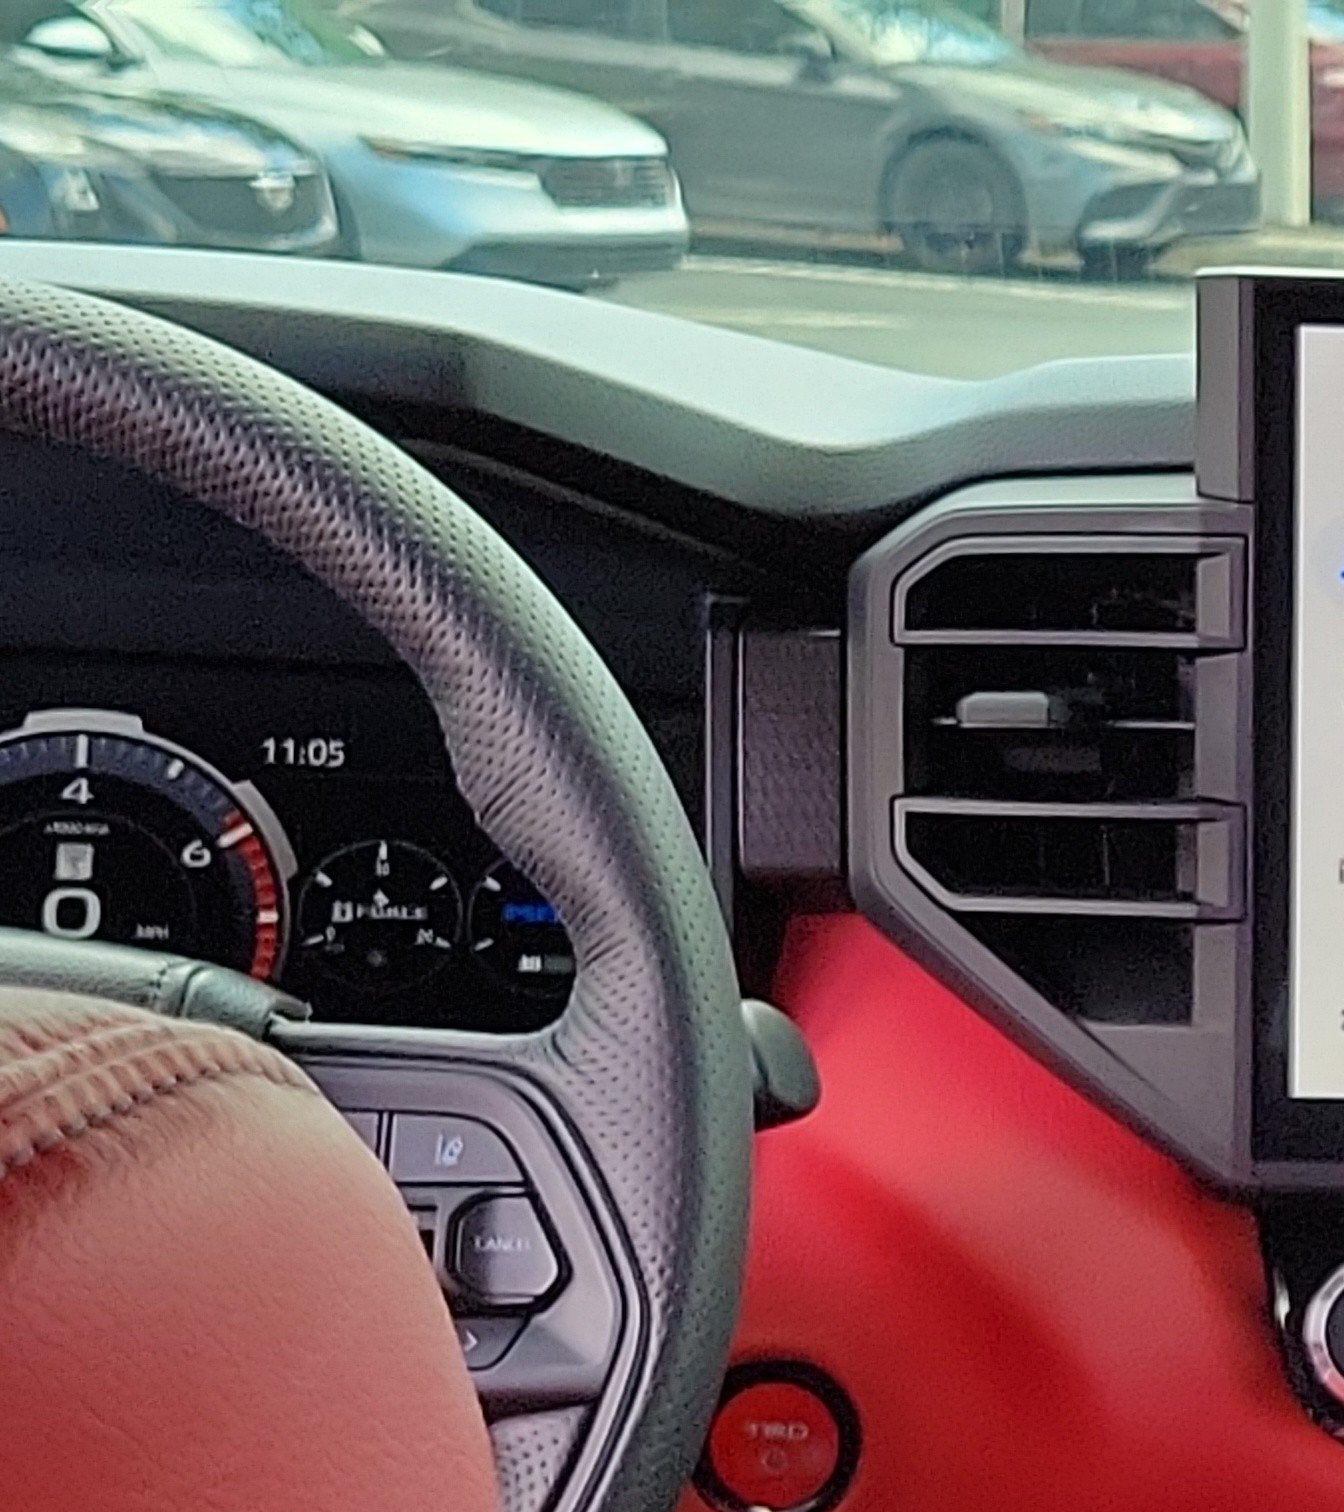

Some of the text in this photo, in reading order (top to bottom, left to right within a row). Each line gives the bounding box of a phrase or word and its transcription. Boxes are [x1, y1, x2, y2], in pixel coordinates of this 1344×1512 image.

[261, 736, 346, 768] 11:05
[60, 777, 95, 805] 4
[181, 838, 213, 869] 6
